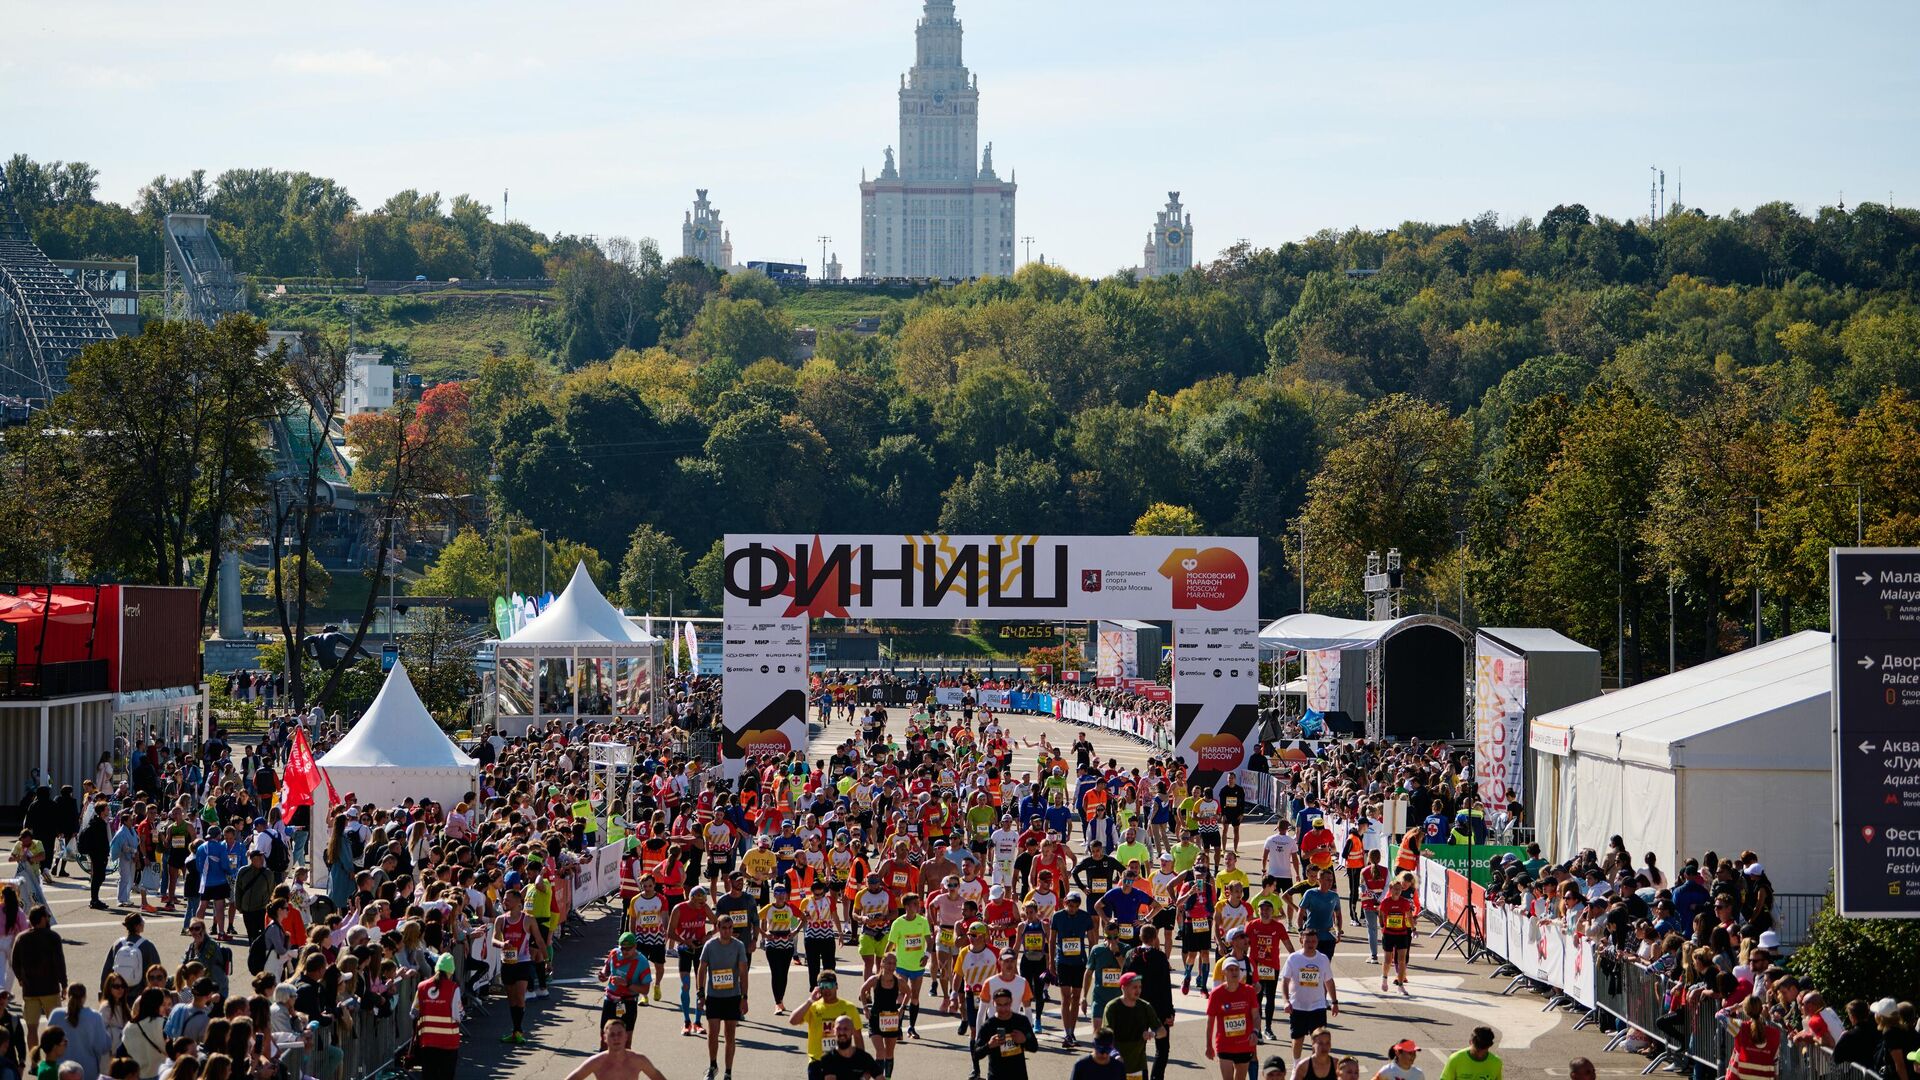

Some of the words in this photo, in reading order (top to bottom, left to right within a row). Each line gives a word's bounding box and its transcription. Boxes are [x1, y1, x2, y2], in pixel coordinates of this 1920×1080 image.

[724, 543, 1068, 607] ФИНИШ
[1105, 569, 1146, 578] Департамент
[1186, 571, 1236, 580] МОСКОВСКИЙ
[1105, 578, 1127, 586] спорта
[1105, 585, 1127, 593] города
[1128, 584, 1153, 592] Москвы
[1186, 591, 1225, 599] MARATHON
[1882, 672, 1919, 684] Palace
[1201, 746, 1241, 754] MARATHON
[712, 974, 732, 984] 12102
[1301, 971, 1317, 980] 8267
[1225, 1018, 1246, 1029] 10349
